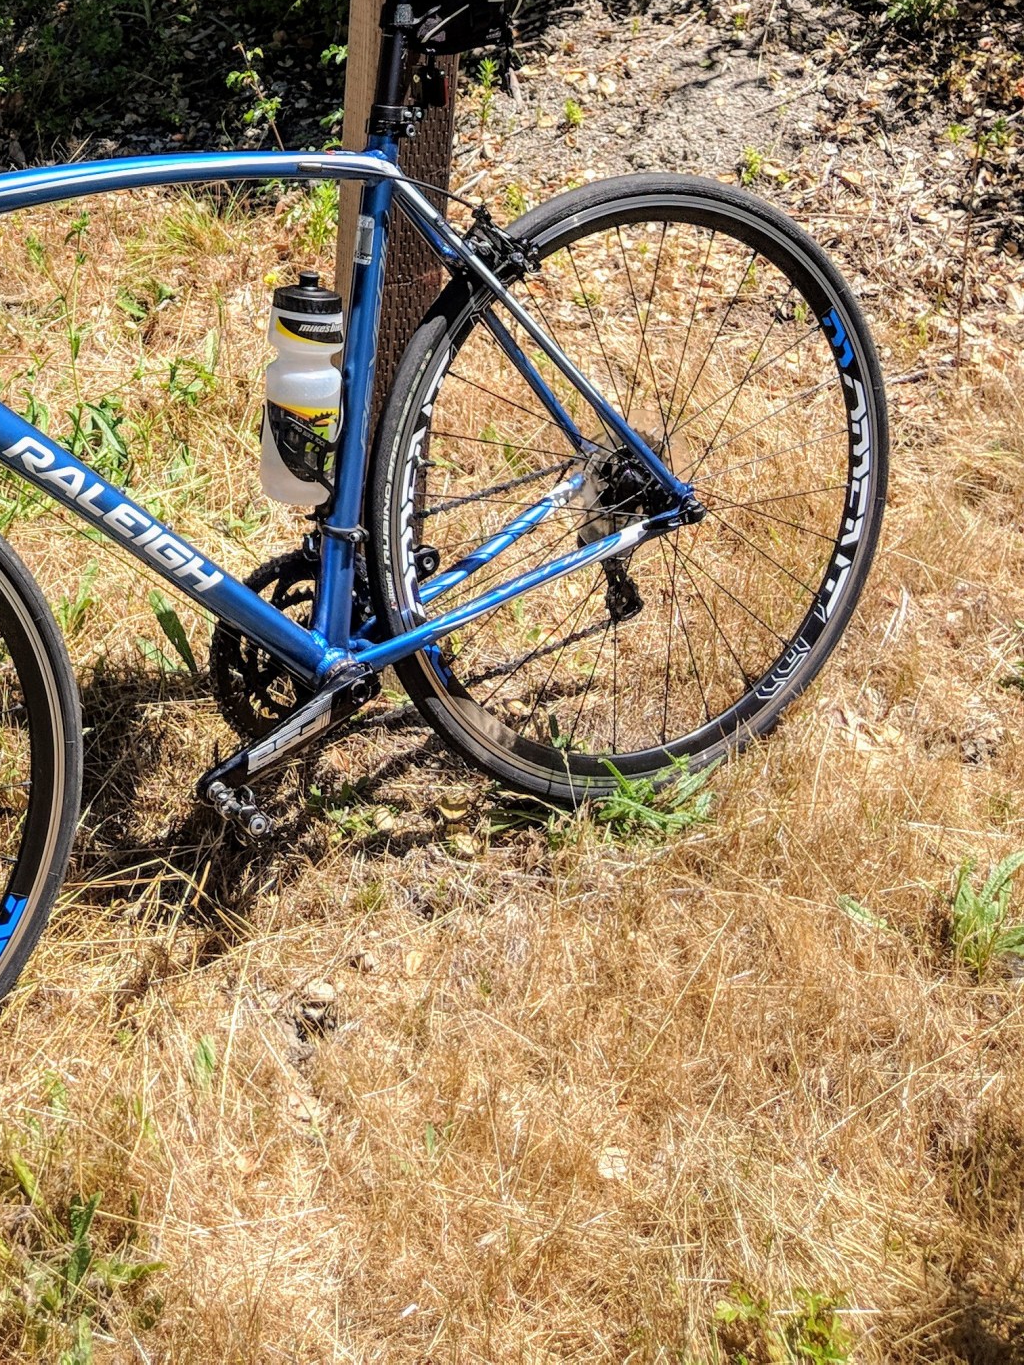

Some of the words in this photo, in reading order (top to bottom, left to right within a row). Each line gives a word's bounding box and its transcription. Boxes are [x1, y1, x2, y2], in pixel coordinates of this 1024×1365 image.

[386, 434, 399, 483] PRO
[2, 436, 225, 593] RALEIGH
[382, 483, 392, 563] RUBINO
